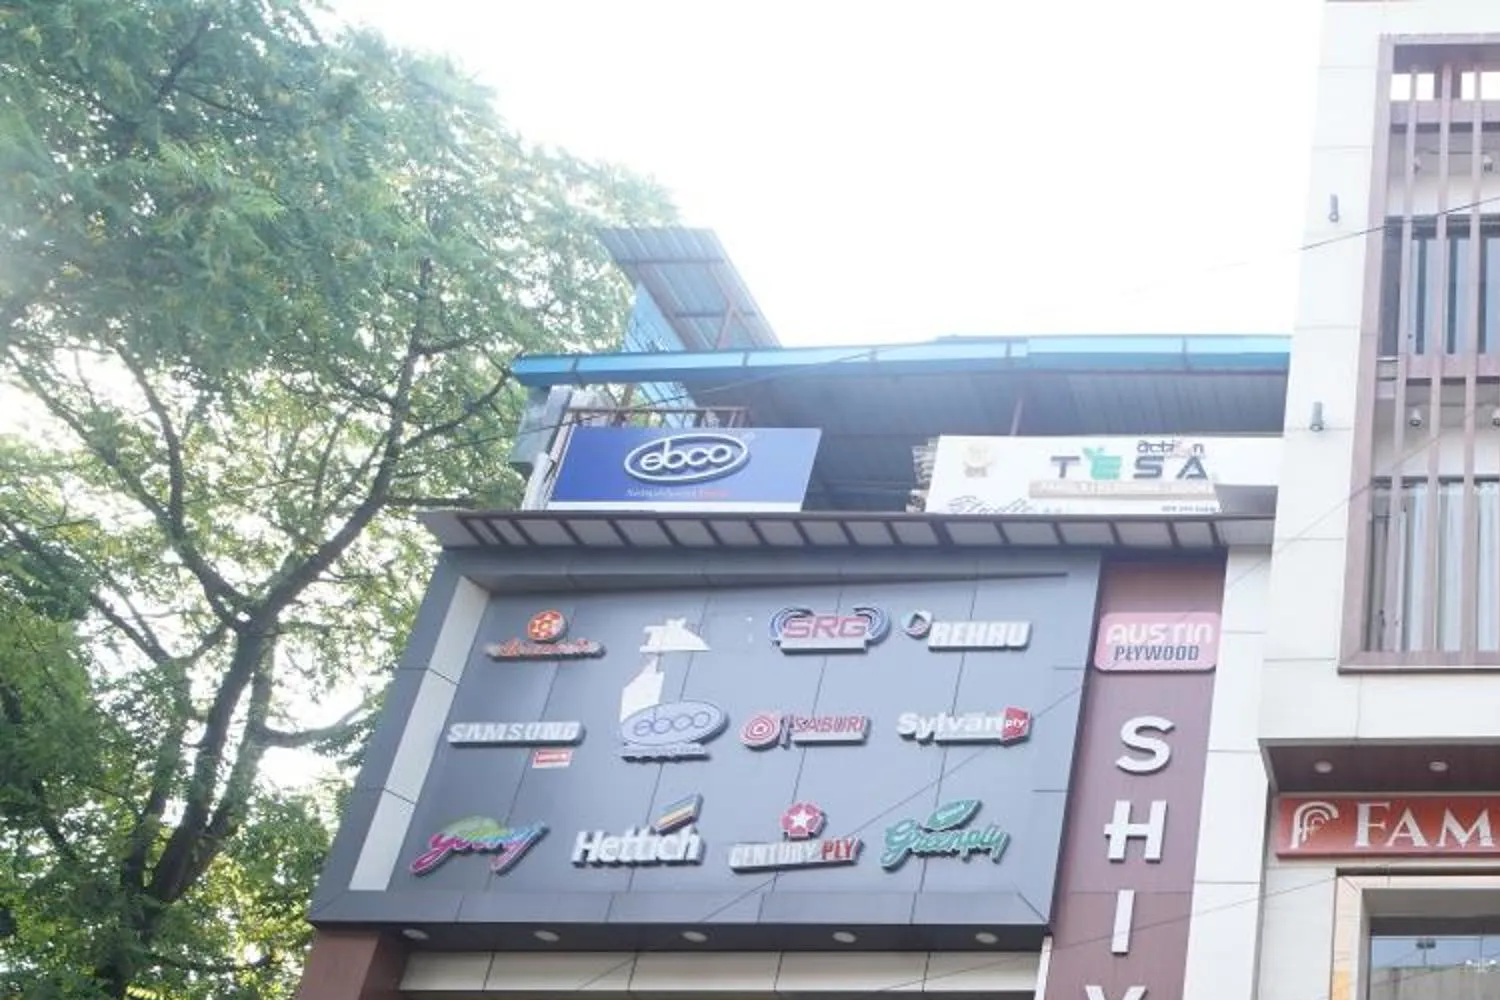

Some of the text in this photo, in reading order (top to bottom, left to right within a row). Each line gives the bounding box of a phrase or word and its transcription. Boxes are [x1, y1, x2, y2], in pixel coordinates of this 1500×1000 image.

[640, 440, 731, 471] ebco
[1050, 447, 1210, 480] TESA
[782, 615, 868, 639] SRG
[928, 621, 1031, 647] REHAU
[1107, 623, 1213, 645] AUSTIN
[1114, 645, 1199, 661] PLYWOOD
[448, 722, 584, 743] SAMSUNG
[633, 704, 712, 737] ebco
[897, 711, 1001, 739] Sylvan
[571, 825, 701, 864] Hettich
